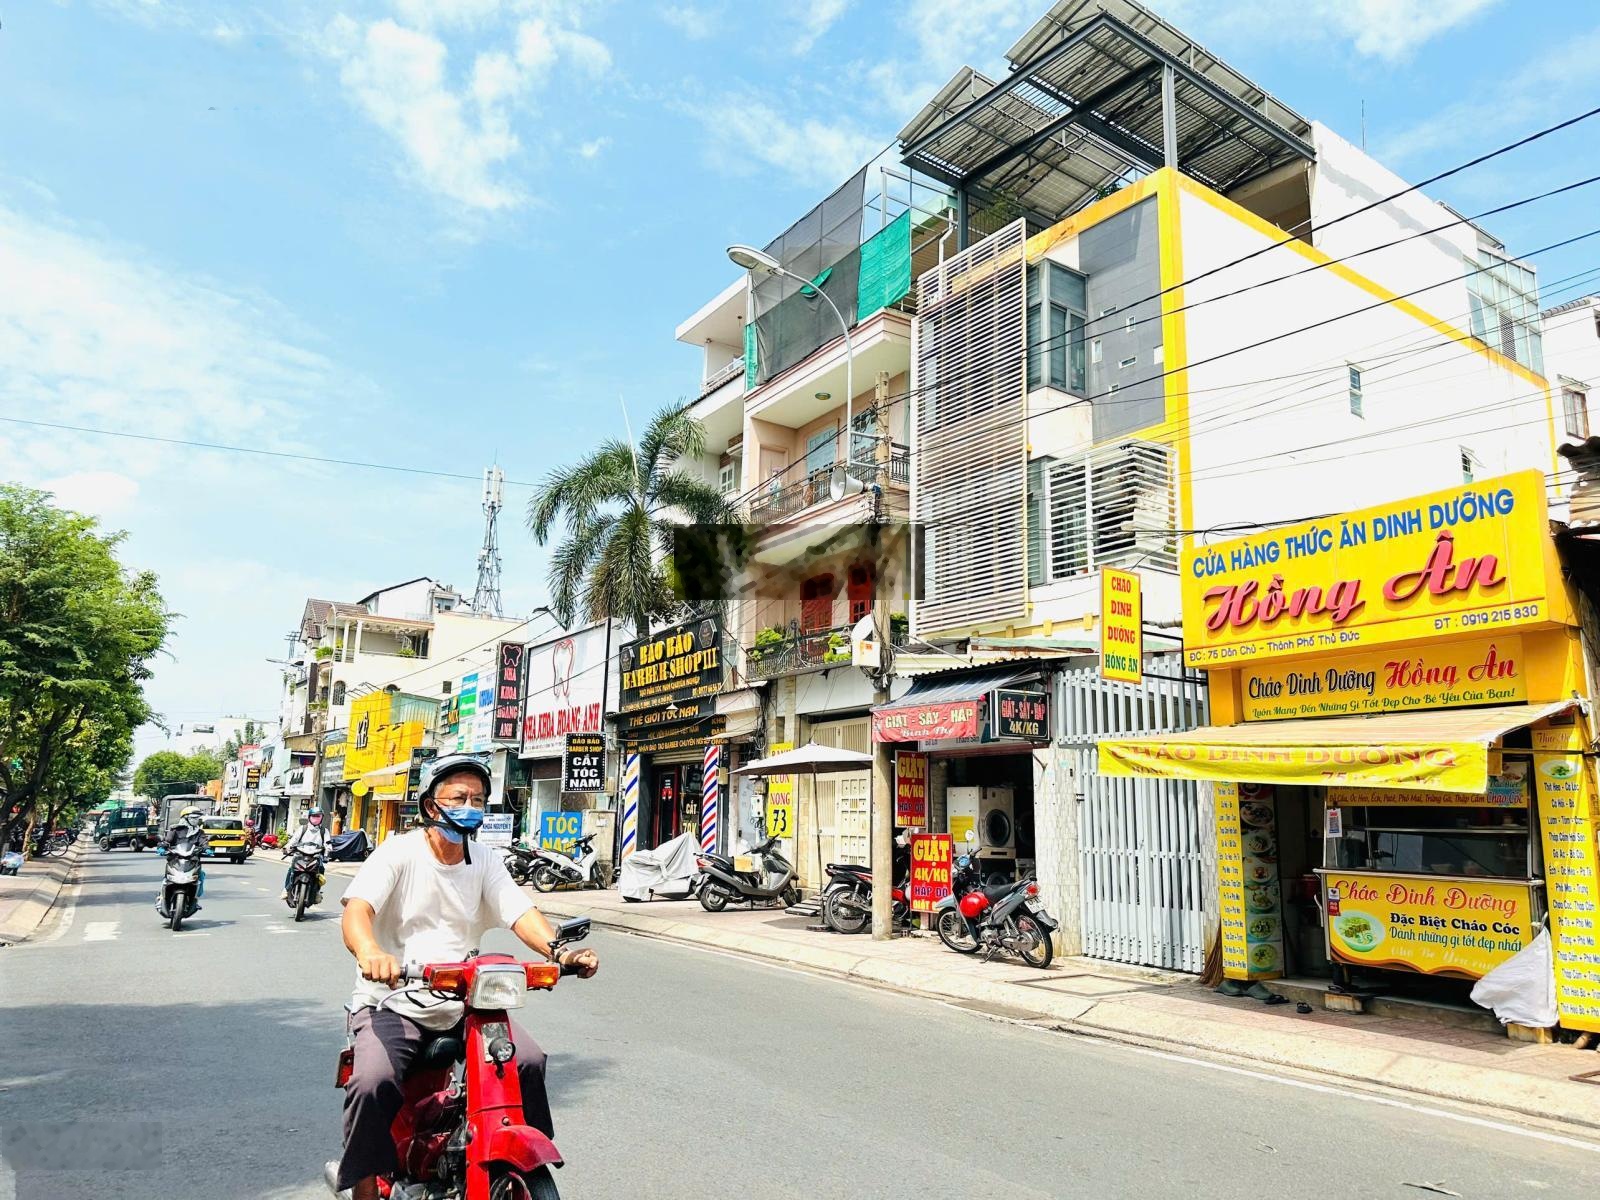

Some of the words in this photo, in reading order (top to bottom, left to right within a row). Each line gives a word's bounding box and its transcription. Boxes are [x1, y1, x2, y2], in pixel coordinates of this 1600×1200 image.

[1193, 549, 1226, 578] CỬA
[1231, 541, 1280, 571] HÀNG
[1285, 526, 1332, 559] THỨC
[1340, 520, 1366, 549] ĂN
[1373, 509, 1422, 541] DINH
[1429, 489, 1514, 529] DƯỠNG
[1203, 573, 1367, 630] Hồng
[1382, 529, 1507, 600] Ân
[1111, 600, 1132, 617] DINH
[1461, 613, 1488, 626] 0919
[1514, 605, 1538, 619] 830
[670, 651, 702, 678] SHOP
[1249, 677, 1283, 699] Cháo
[1286, 672, 1321, 695] Dinh
[1326, 669, 1376, 695] Dưỡng
[1384, 658, 1459, 690] Hồng
[1467, 644, 1518, 681] Ân
[1009, 720, 1039, 735] 4K/KG
[572, 754, 599, 766] CẮT
[572, 767, 598, 778] TÓC
[569, 779, 600, 788] NAM
[546, 812, 578, 834] TÓC
[773, 809, 787, 832] 73
[913, 836, 949, 866] GIẶT
[914, 868, 948, 882] 4K/KG
[1335, 880, 1379, 901] Cháo
[1390, 912, 1415, 927] Đặc
[1419, 915, 1447, 930] Biệt
[1451, 918, 1488, 932] Cháo
[1492, 921, 1520, 935] Cóc
